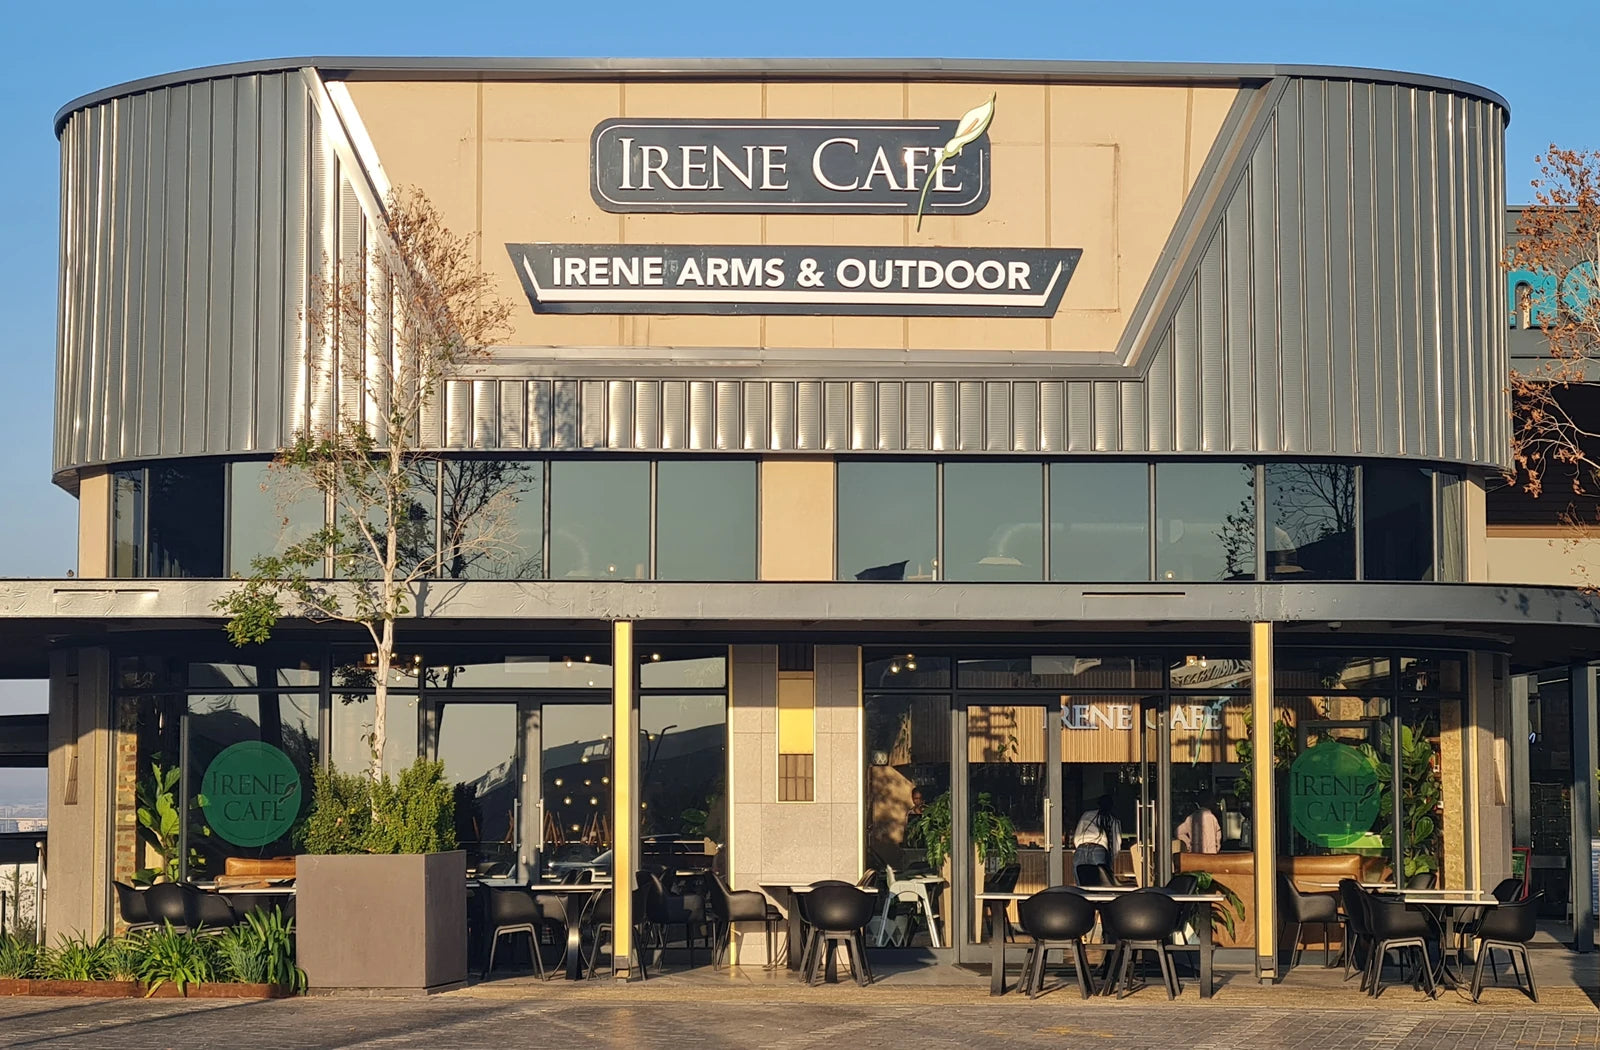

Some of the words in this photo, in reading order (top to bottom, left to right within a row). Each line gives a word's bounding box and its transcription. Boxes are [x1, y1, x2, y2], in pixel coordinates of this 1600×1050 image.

[618, 137, 789, 191] IRENE
[812, 137, 963, 192] CAFE
[552, 257, 664, 286] IRENE
[676, 257, 785, 288] ARMS
[796, 257, 825, 288] &
[836, 258, 1031, 290] OUTDOOR
[212, 771, 286, 796] IRENE
[1294, 772, 1365, 796] IRENE
[223, 800, 286, 822] CAFE
[1307, 801, 1365, 822] CAFE
